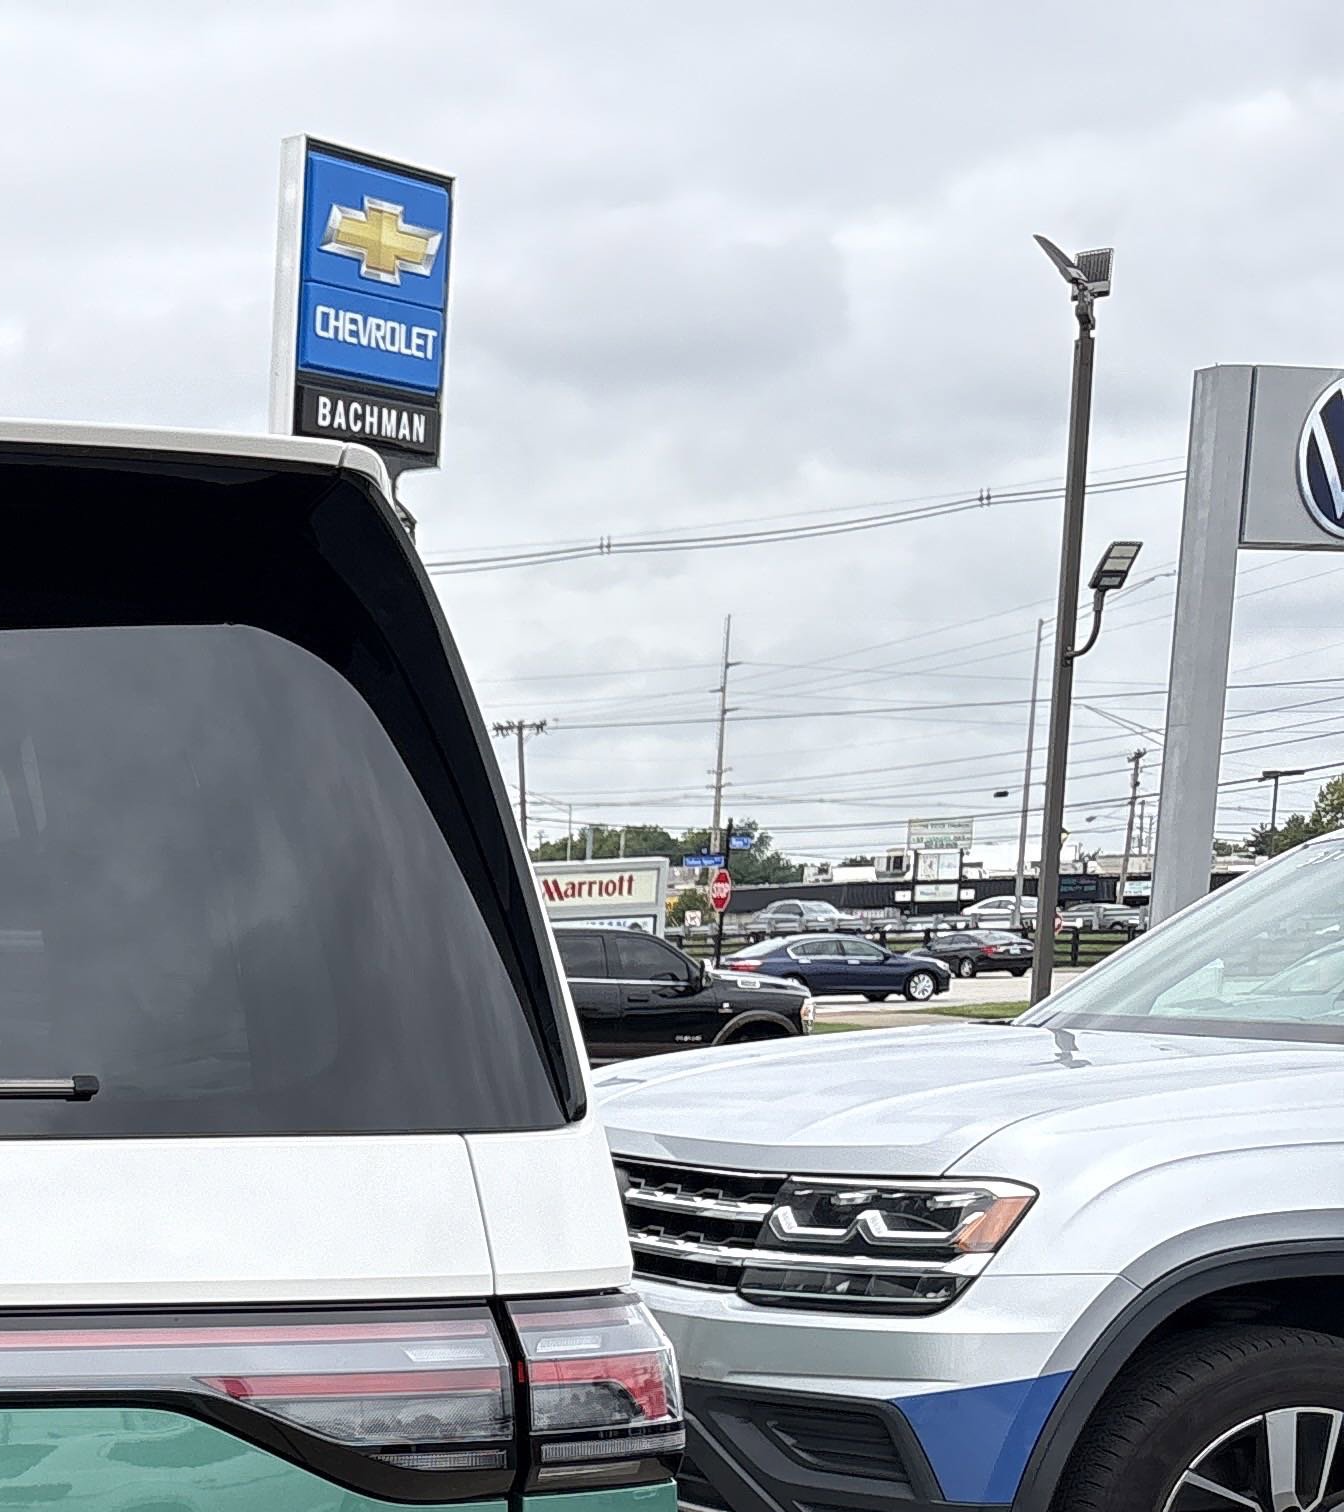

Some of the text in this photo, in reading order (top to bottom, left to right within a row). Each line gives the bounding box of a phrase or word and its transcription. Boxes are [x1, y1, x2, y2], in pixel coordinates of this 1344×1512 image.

[315, 304, 438, 360] CHEVROLET
[317, 395, 427, 444] BACHMAN
[542, 873, 636, 902] Marriott
[711, 881, 730, 899] STOP
